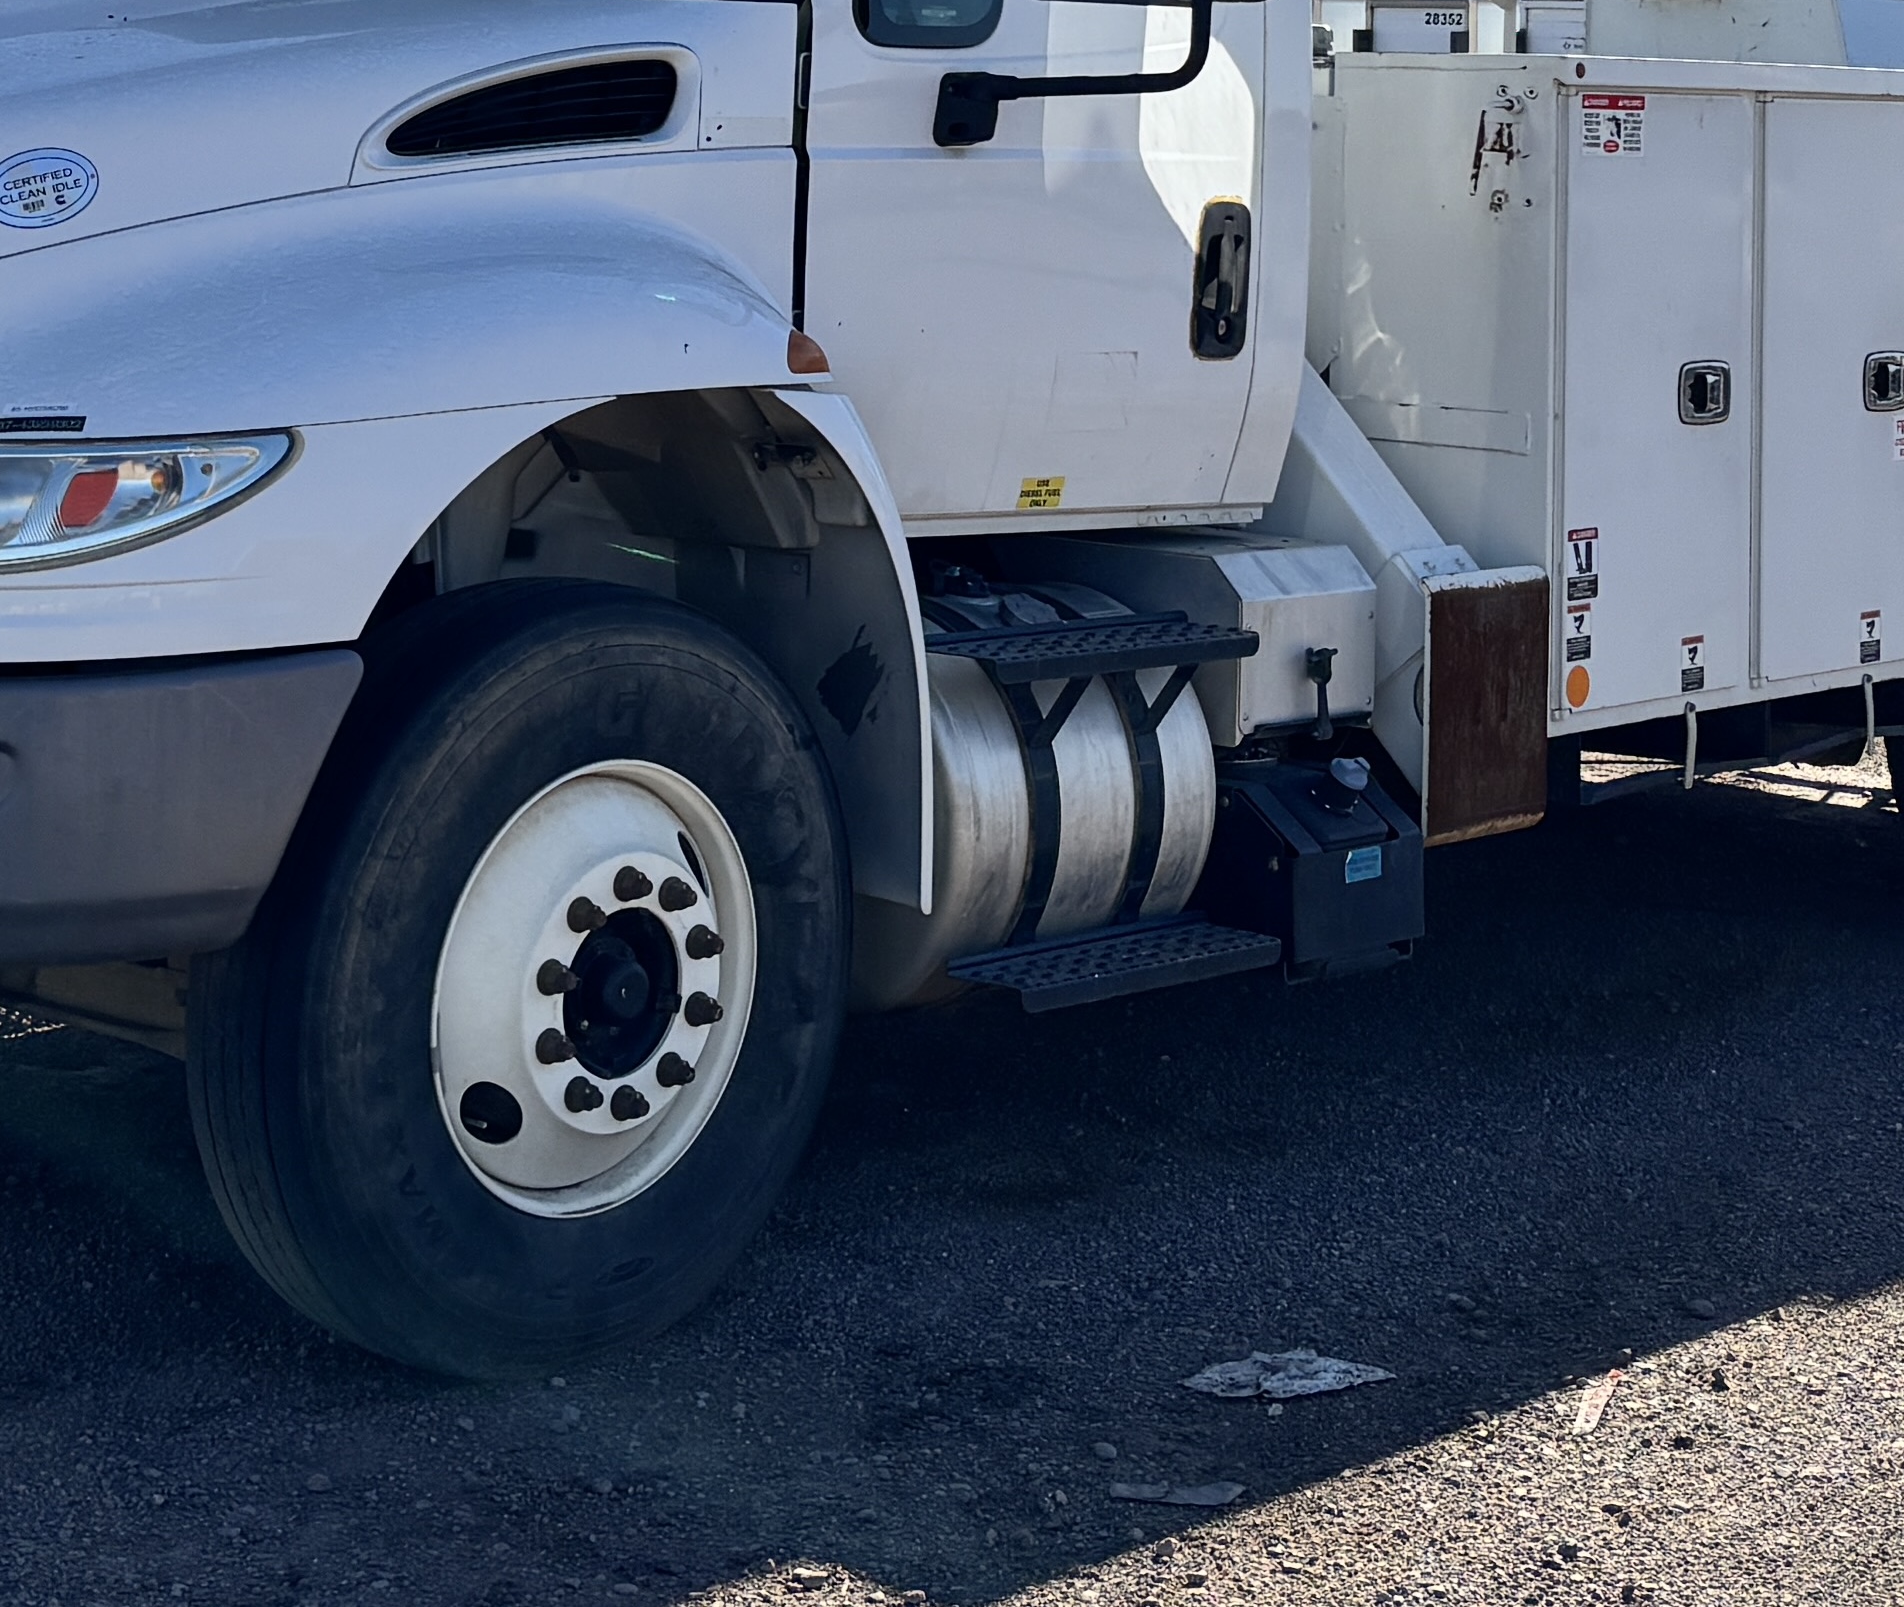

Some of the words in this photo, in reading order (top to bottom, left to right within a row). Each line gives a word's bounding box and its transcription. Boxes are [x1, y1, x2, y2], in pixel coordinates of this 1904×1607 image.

[1424, 12, 1463, 26] 28352
[3, 167, 73, 191] CERTIFIED
[0, 186, 47, 206] CLEAN
[52, 178, 83, 194] IDLE
